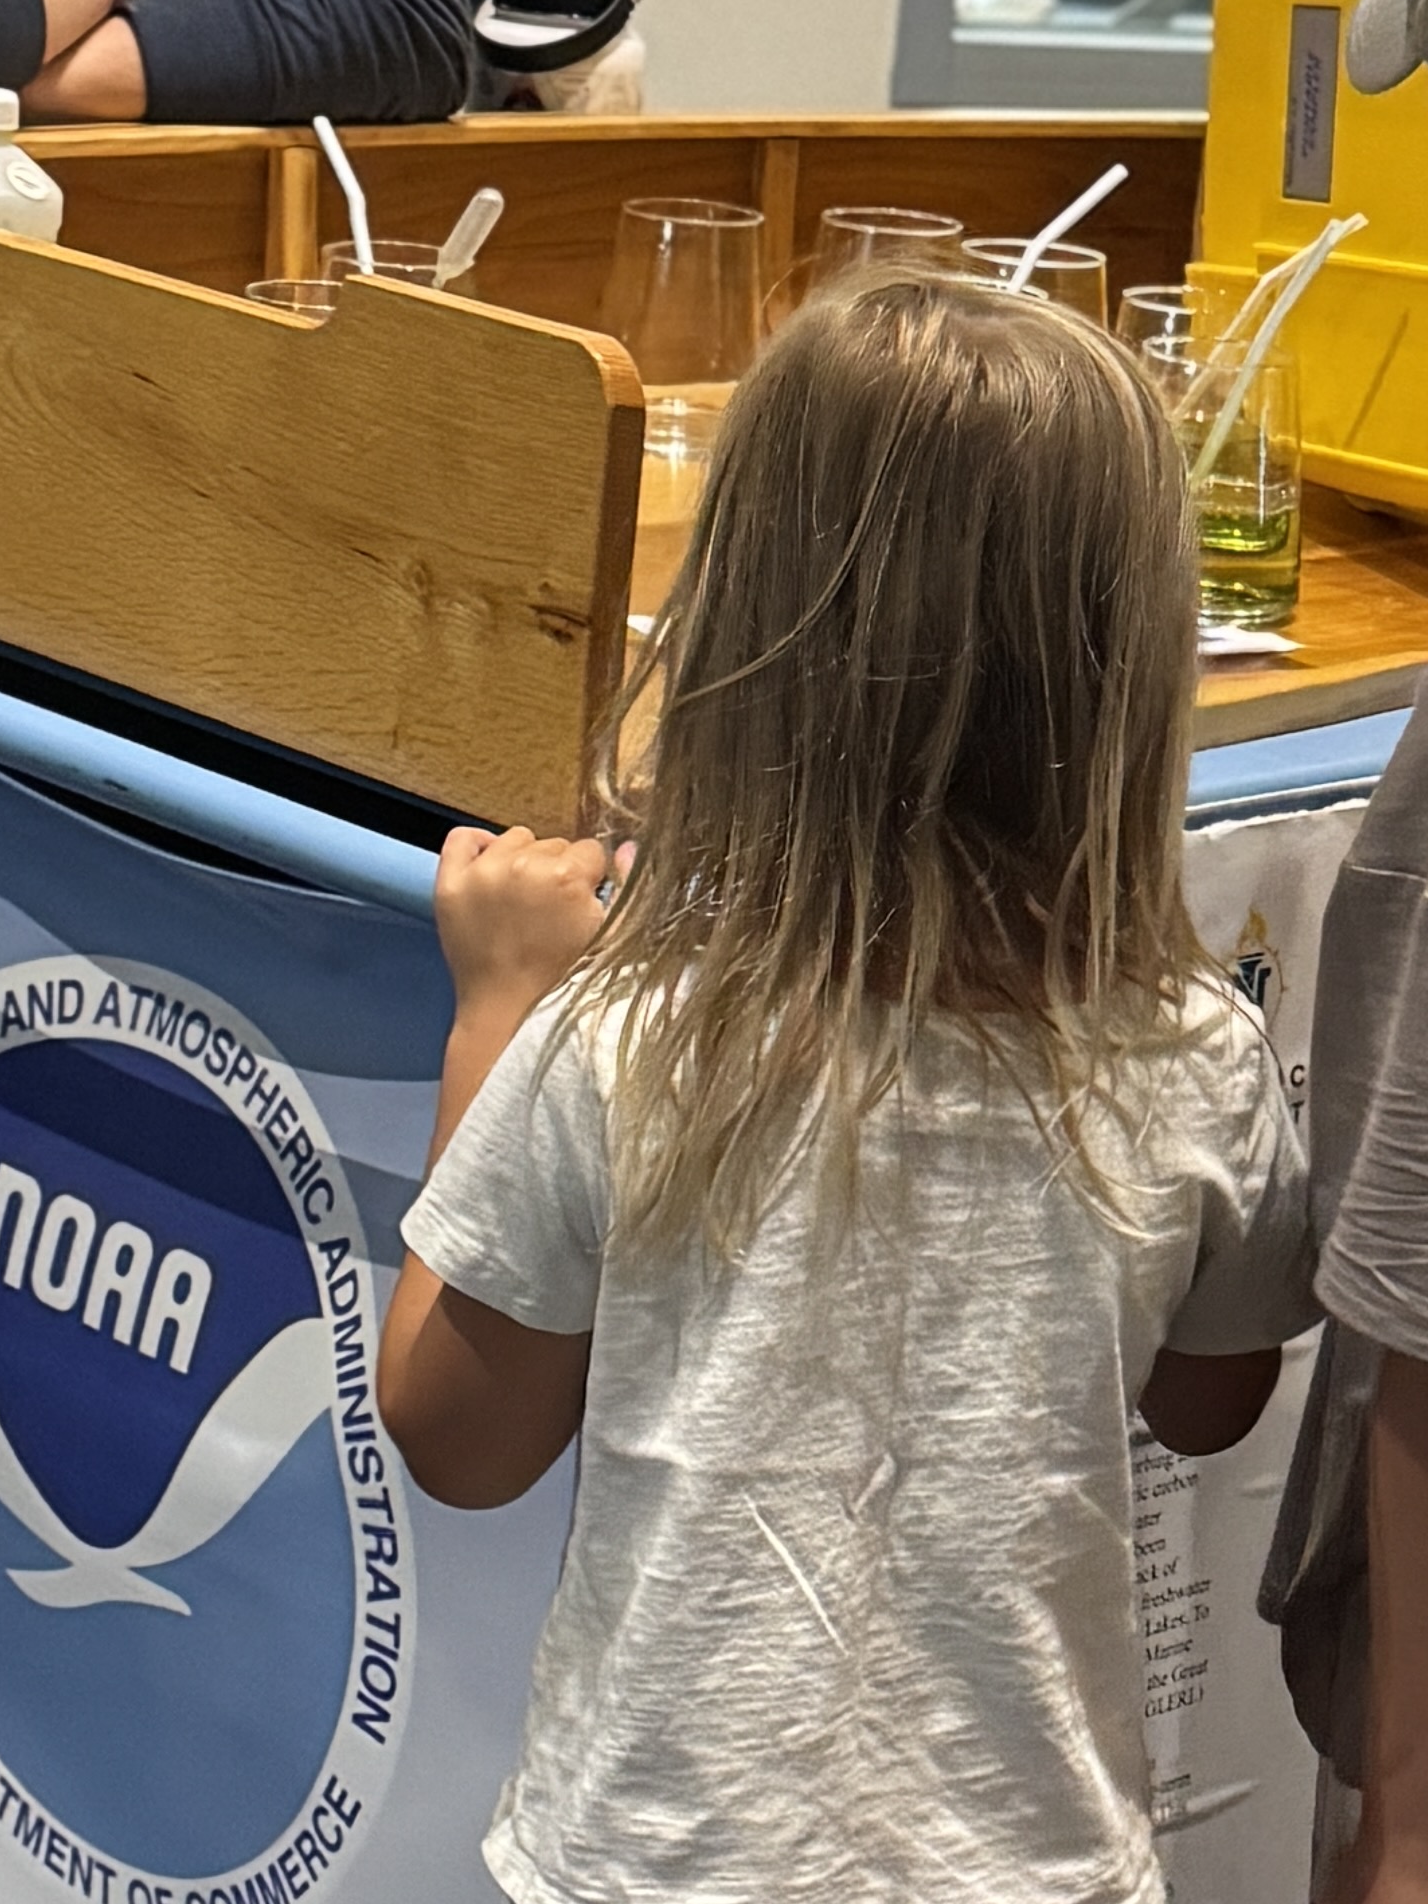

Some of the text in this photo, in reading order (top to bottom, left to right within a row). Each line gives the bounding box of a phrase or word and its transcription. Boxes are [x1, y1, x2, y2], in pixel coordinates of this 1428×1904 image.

[0, 978, 83, 1038] AND
[93, 982, 334, 1227] ATMOSPHERIC
[317, 1237, 401, 1745] ADMINISTRATION
